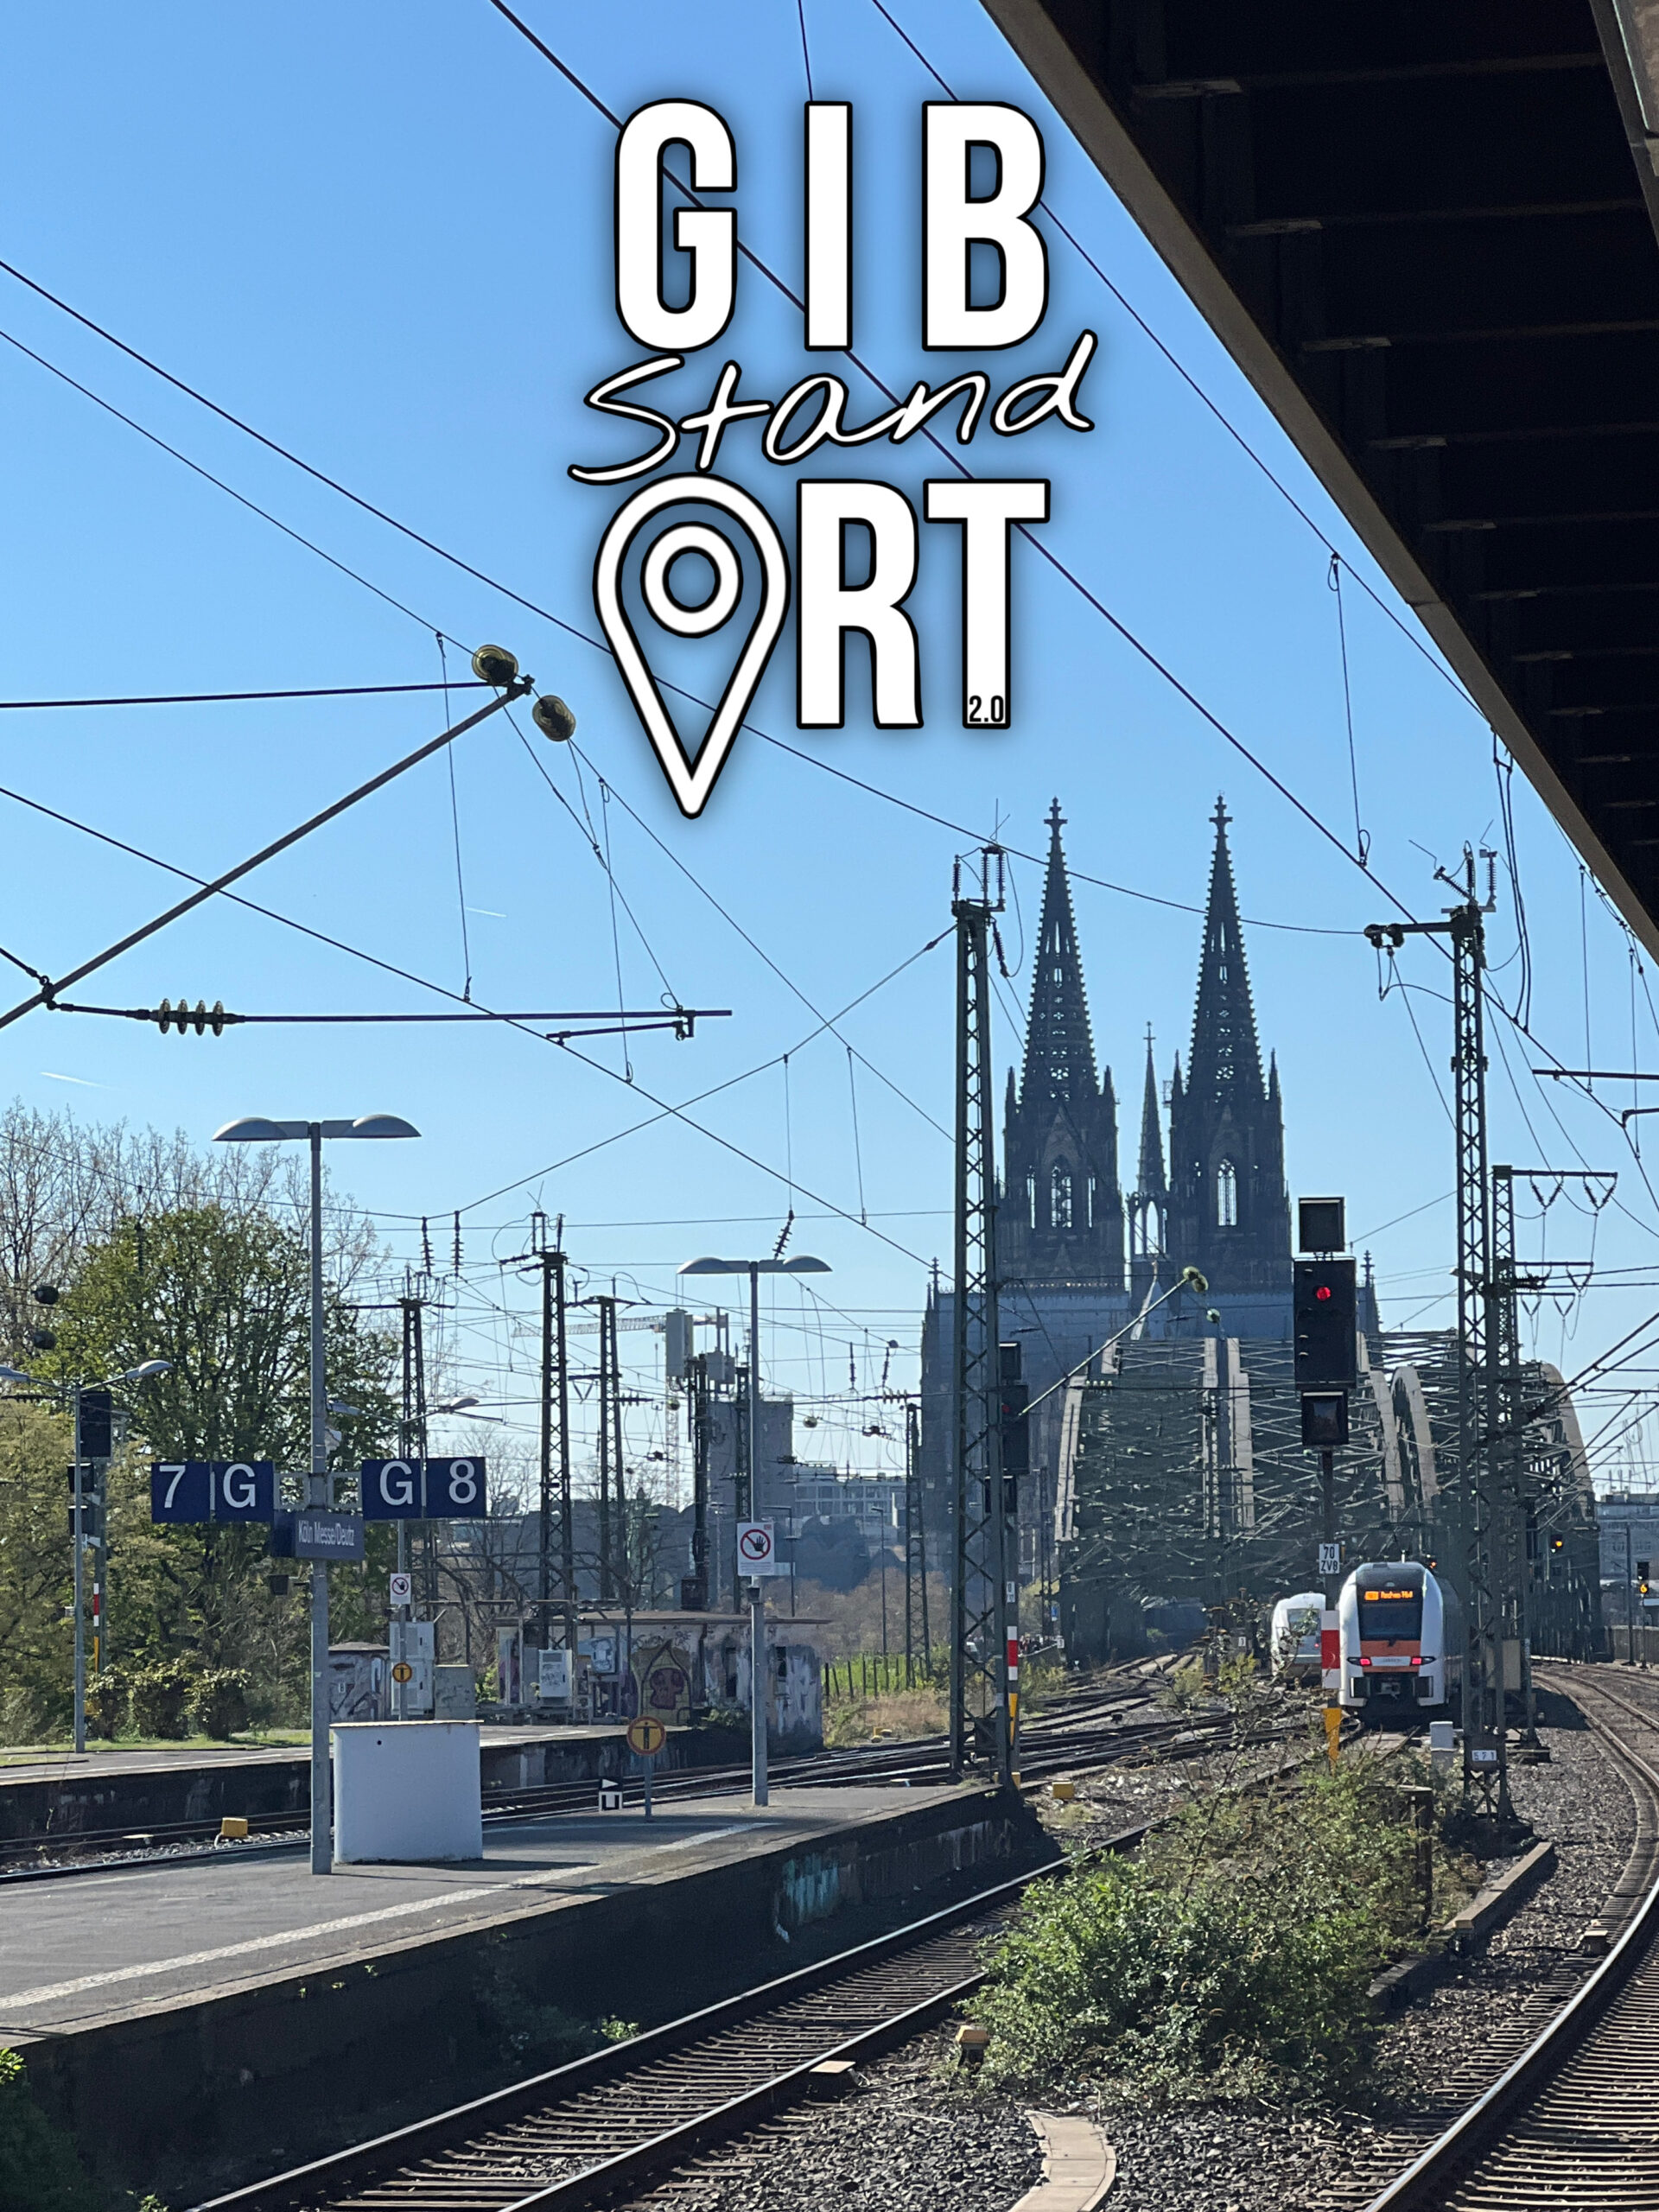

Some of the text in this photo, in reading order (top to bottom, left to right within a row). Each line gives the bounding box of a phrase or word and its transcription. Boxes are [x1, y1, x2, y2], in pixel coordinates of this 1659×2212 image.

[159, 1463, 256, 1509] 7 G
[380, 1459, 477, 1506] G 8
[1320, 1560, 1338, 1572] ZV8
[1324, 1547, 1335, 1559] 70
